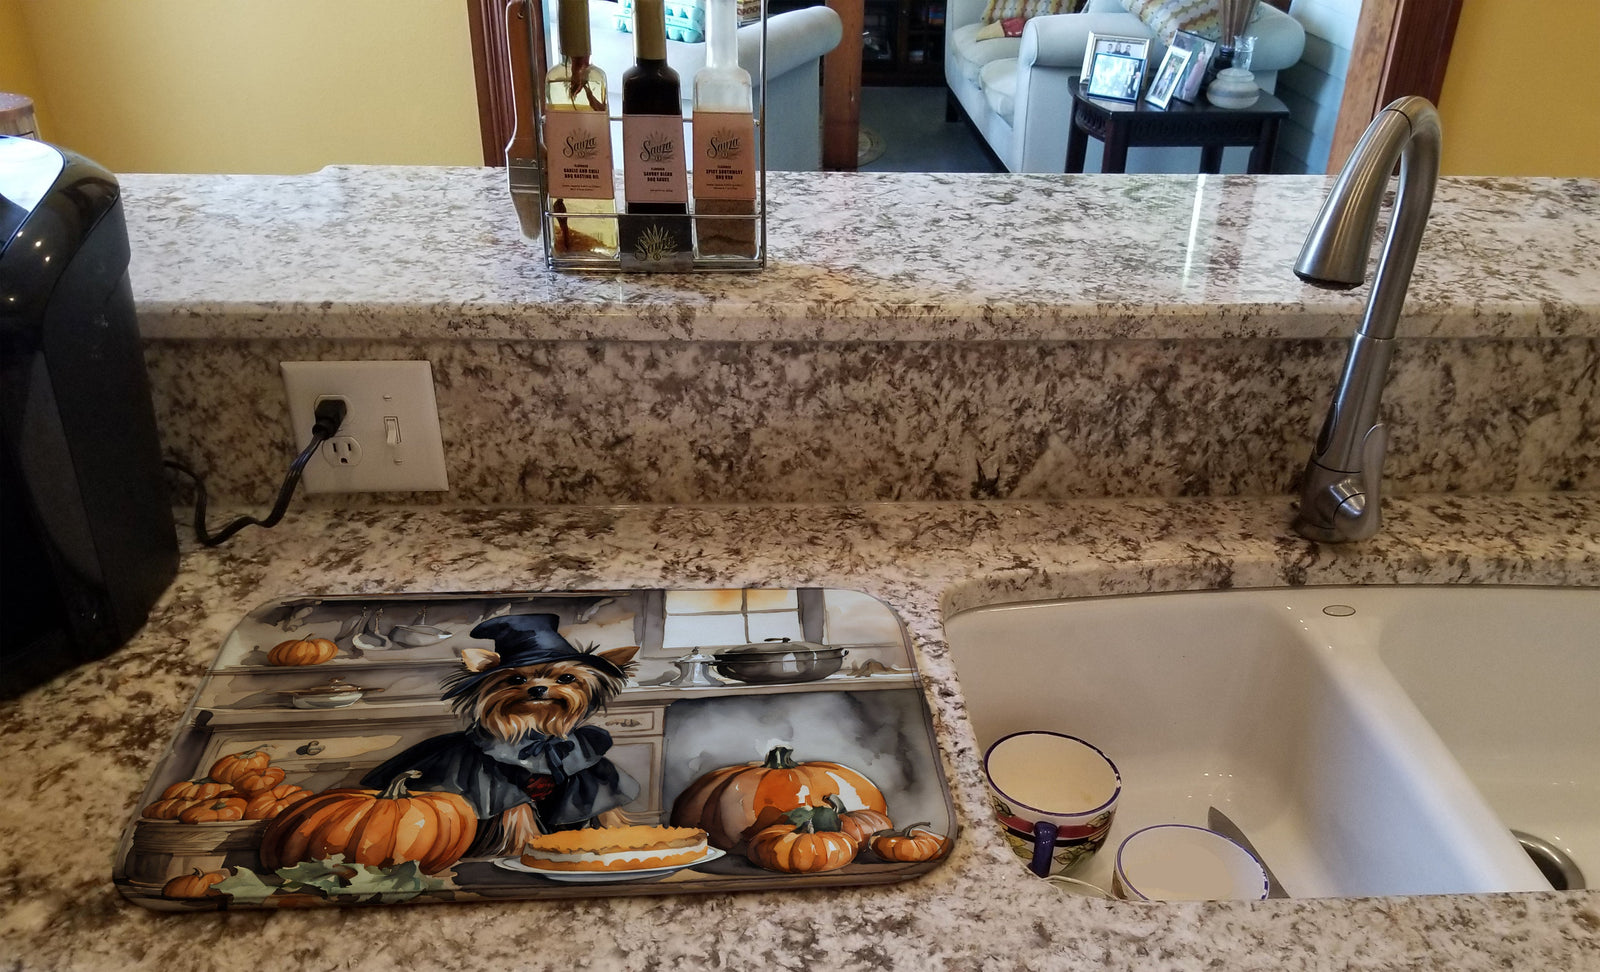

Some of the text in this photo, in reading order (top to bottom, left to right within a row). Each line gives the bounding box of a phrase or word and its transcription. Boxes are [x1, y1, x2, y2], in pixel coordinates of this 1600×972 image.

[562, 136, 598, 158] Sauza
[640, 140, 674, 161] Sauza
[706, 137, 740, 158] Sauza
